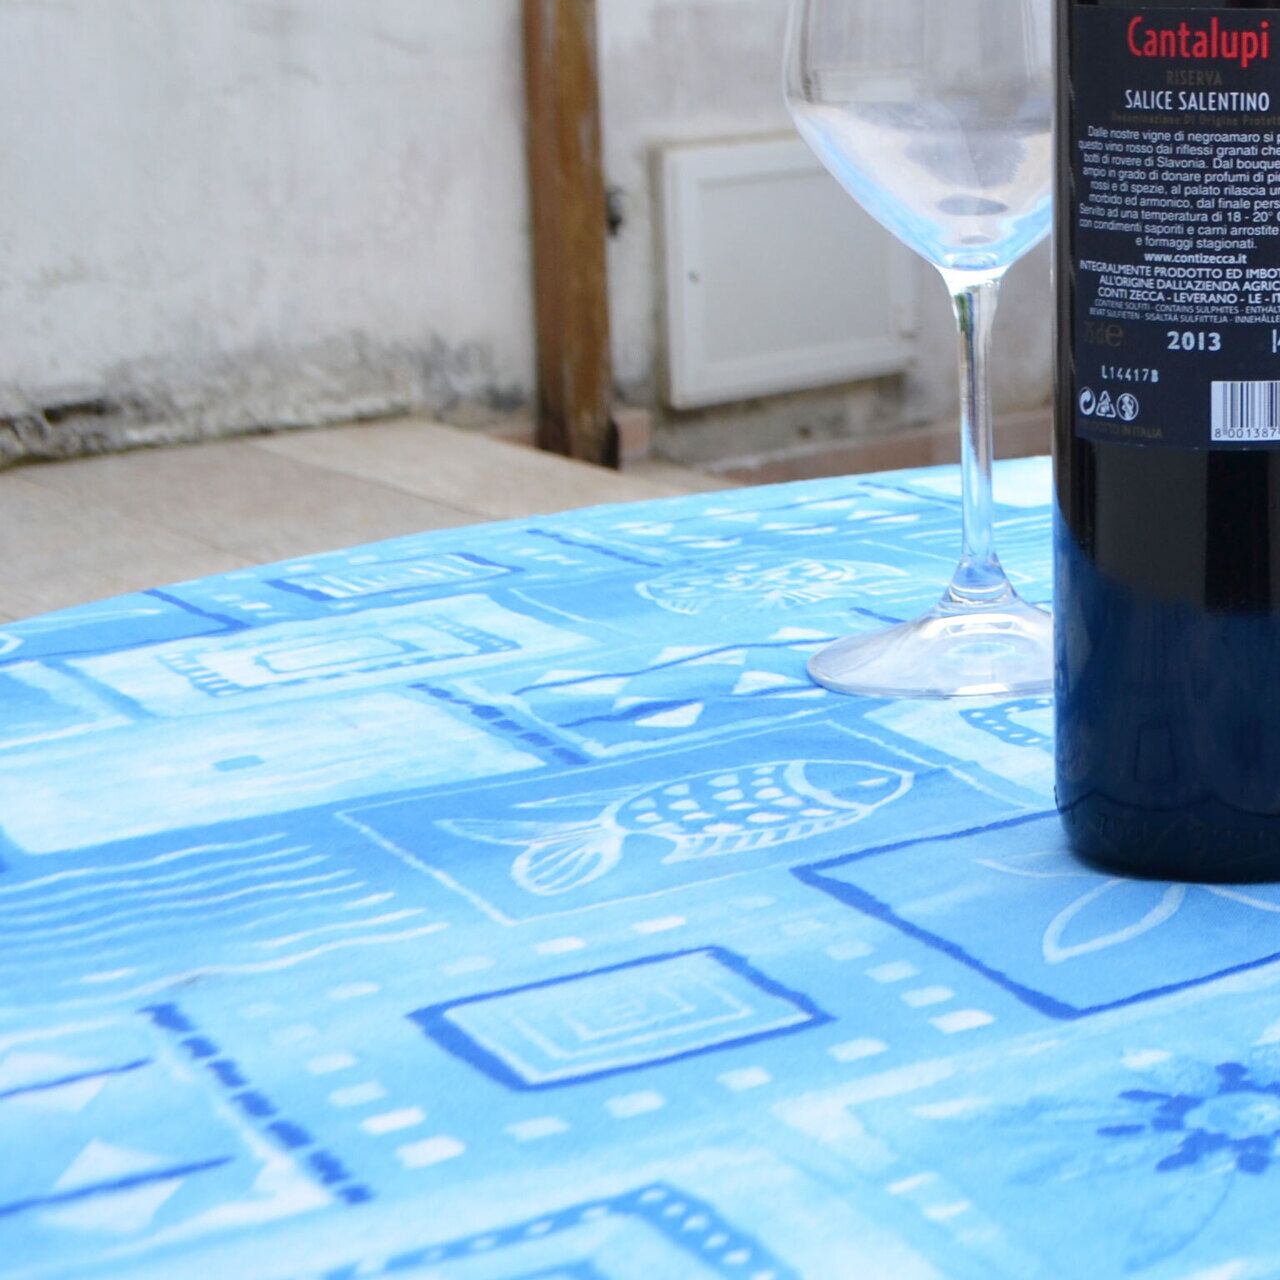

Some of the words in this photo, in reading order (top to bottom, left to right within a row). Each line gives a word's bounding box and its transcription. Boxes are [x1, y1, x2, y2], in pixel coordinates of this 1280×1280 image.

[1127, 15, 1270, 68] Cantalupi
[1166, 70, 1223, 86] RISERVA
[1125, 89, 1173, 110] SALICE
[1178, 91, 1270, 112] SALENTINO
[1087, 125, 1108, 138] Dalle
[1110, 129, 1140, 140] nostre
[1141, 129, 1171, 143] vigne
[1174, 130, 1185, 142] di
[1188, 132, 1260, 145] negroamaro
[1263, 131, 1274, 143] si
[1105, 142, 1124, 152] vino
[1125, 144, 1153, 154] rosso
[1156, 143, 1173, 154] dai
[1176, 144, 1213, 156] riflessi
[1216, 145, 1258, 158] granati
[1101, 154, 1110, 164] di
[1111, 156, 1142, 166] rovere
[1144, 156, 1154, 167] di
[1157, 156, 1208, 169] Slavonia.
[1212, 158, 1233, 169] Dal
[1108, 167, 1116, 178] in
[1118, 168, 1146, 181] grado
[1148, 170, 1159, 181] di
[1161, 170, 1201, 182] donare
[1204, 171, 1250, 184] profumi
[1252, 171, 1264, 182] di
[1111, 182, 1118, 191] e
[1119, 182, 1129, 192] di
[1130, 183, 1168, 196] spezie,
[1170, 184, 1181, 195] al
[1184, 184, 1221, 197] palato
[1224, 184, 1266, 196] rilascia
[1124, 195, 1137, 206] ed
[1196, 197, 1215, 209] dal
[1218, 197, 1251, 209] finale
[1107, 207, 1119, 218] ad
[1120, 209, 1139, 219] una
[1141, 210, 1209, 223] temperatura
[1211, 211, 1223, 222] di
[1227, 211, 1241, 222] 18
[1252, 211, 1273, 222] 20°
[1093, 220, 1142, 231] condimenti
[1144, 224, 1184, 236] saporiti
[1186, 225, 1195, 235] e
[1197, 225, 1227, 236] carni
[1230, 224, 1279, 236] arrostite
[1135, 237, 1143, 246] e
[1144, 236, 1193, 251] formaggi
[1196, 238, 1257, 251] stagionati.
[1144, 253, 1247, 264] www.contizecca.it
[1079, 260, 1152, 277] INTEGRALMENTE
[1154, 267, 1223, 279] PRODOTTO
[1226, 268, 1243, 279] ED
[1099, 275, 1155, 289] ALL'ORIGINE
[1156, 279, 1240, 291] DALL'AZIENDA
[1097, 287, 1128, 299] CONTI
[1129, 289, 1166, 302] ZECCA
[1173, 292, 1238, 304] LEVERANO
[1248, 293, 1262, 304] LE
[1167, 331, 1221, 351] 2013
[1228, 427, 1276, 438] 001387
